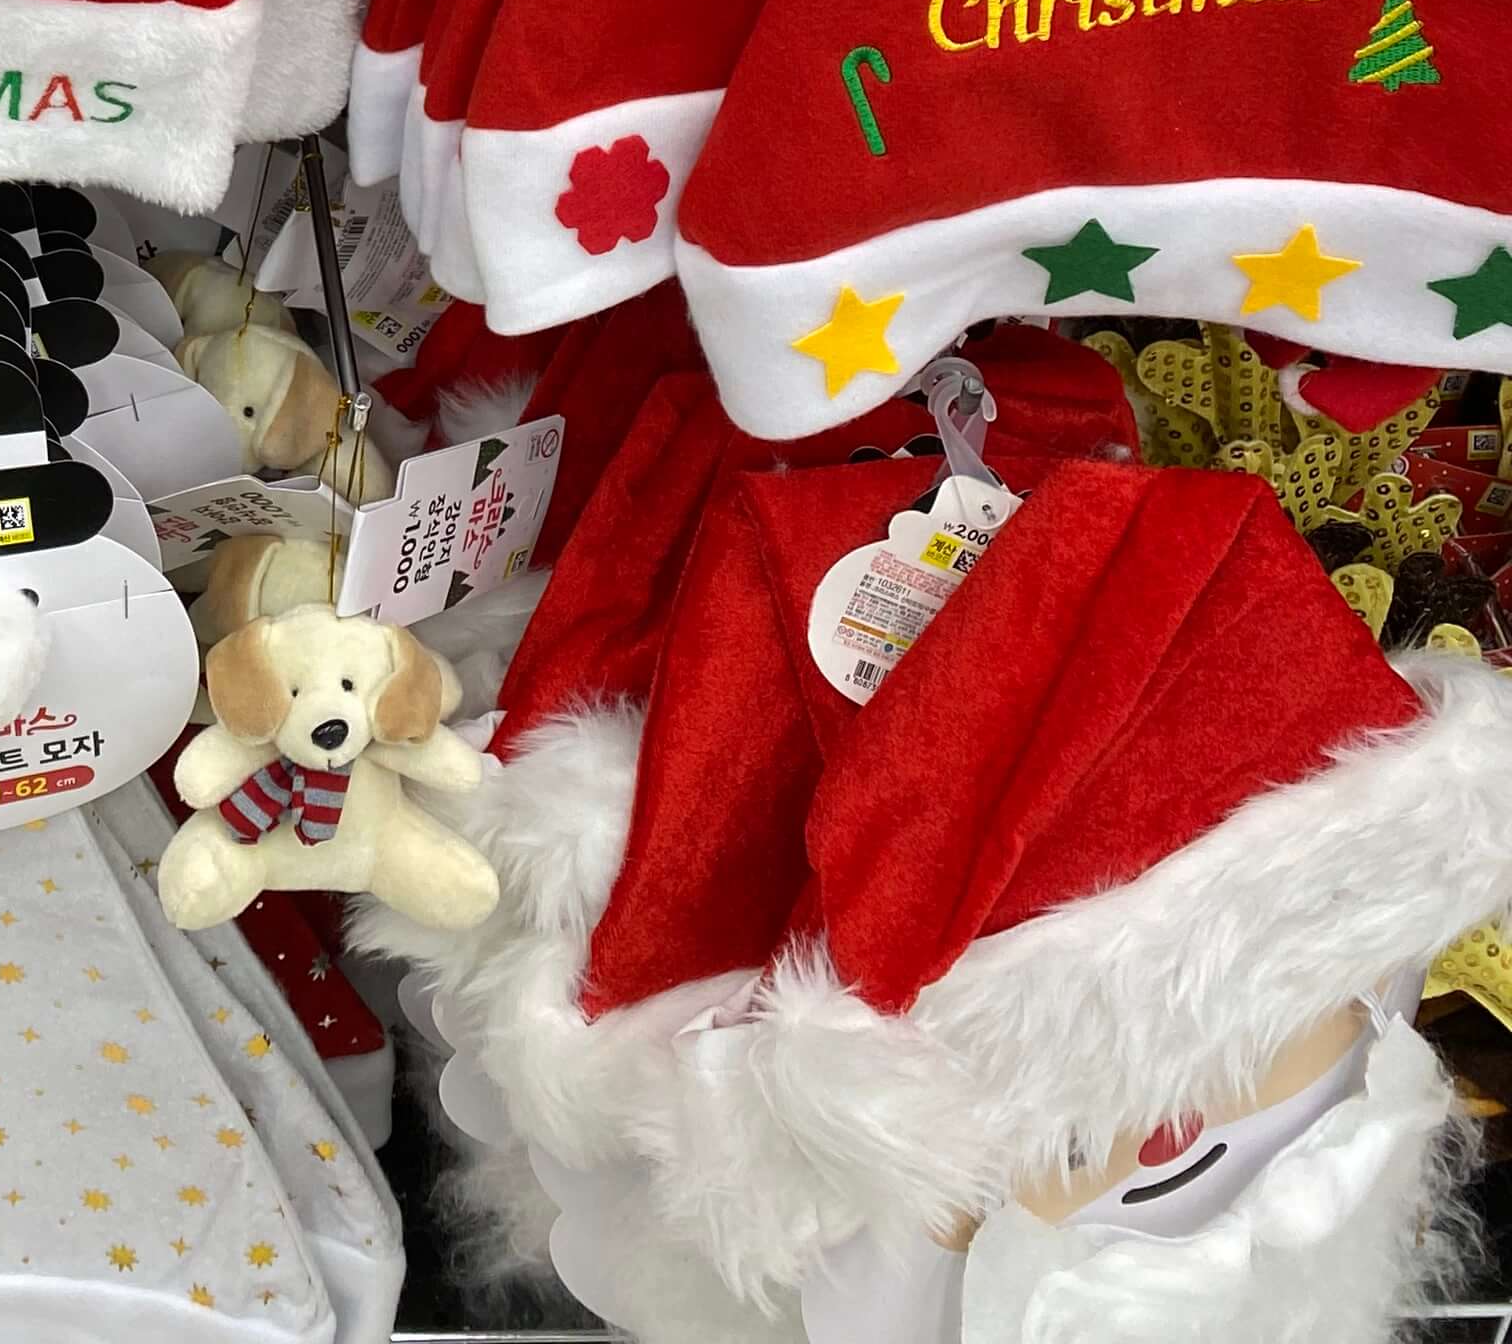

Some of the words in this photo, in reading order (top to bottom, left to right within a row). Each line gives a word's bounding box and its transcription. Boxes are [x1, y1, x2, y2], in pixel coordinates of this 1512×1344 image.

[435, 499, 462, 567] 강아지
[462, 498, 487, 553] 마스
[473, 468, 506, 570] 크리스
[930, 538, 958, 557] 계산
[39, 730, 105, 765] 모자
[55, 776, 77, 788] cm
